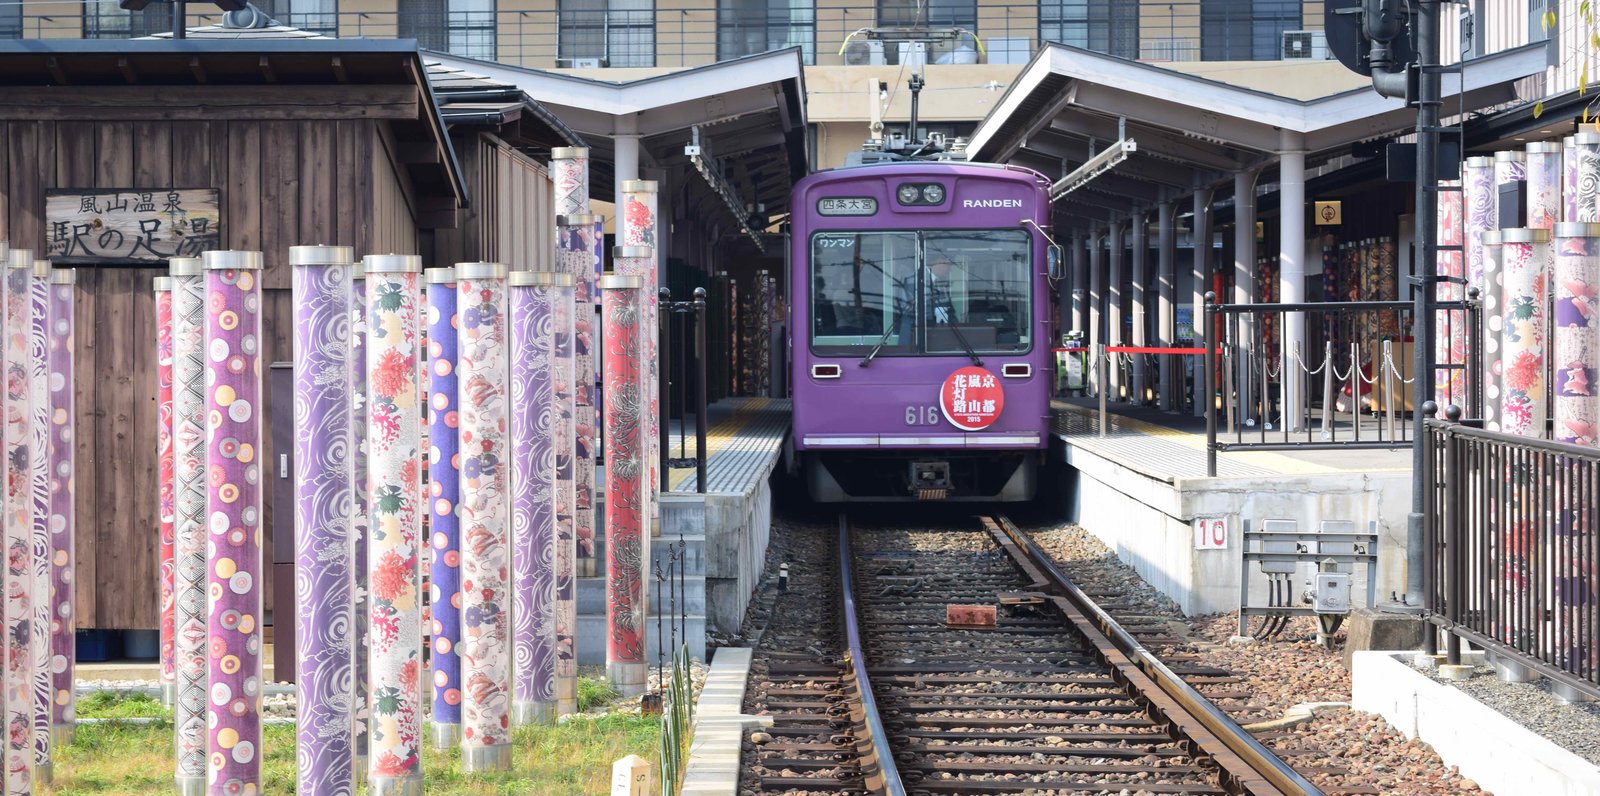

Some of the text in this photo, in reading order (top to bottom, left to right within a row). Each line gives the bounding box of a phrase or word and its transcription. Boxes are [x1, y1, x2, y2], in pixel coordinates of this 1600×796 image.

[823, 199, 873, 210] 四条大宮
[963, 199, 1022, 208] RANDEN
[50, 217, 217, 258] 駅の足湯
[820, 239, 855, 248] ワンマン
[905, 406, 938, 425] 616
[1199, 520, 1225, 546] 10
